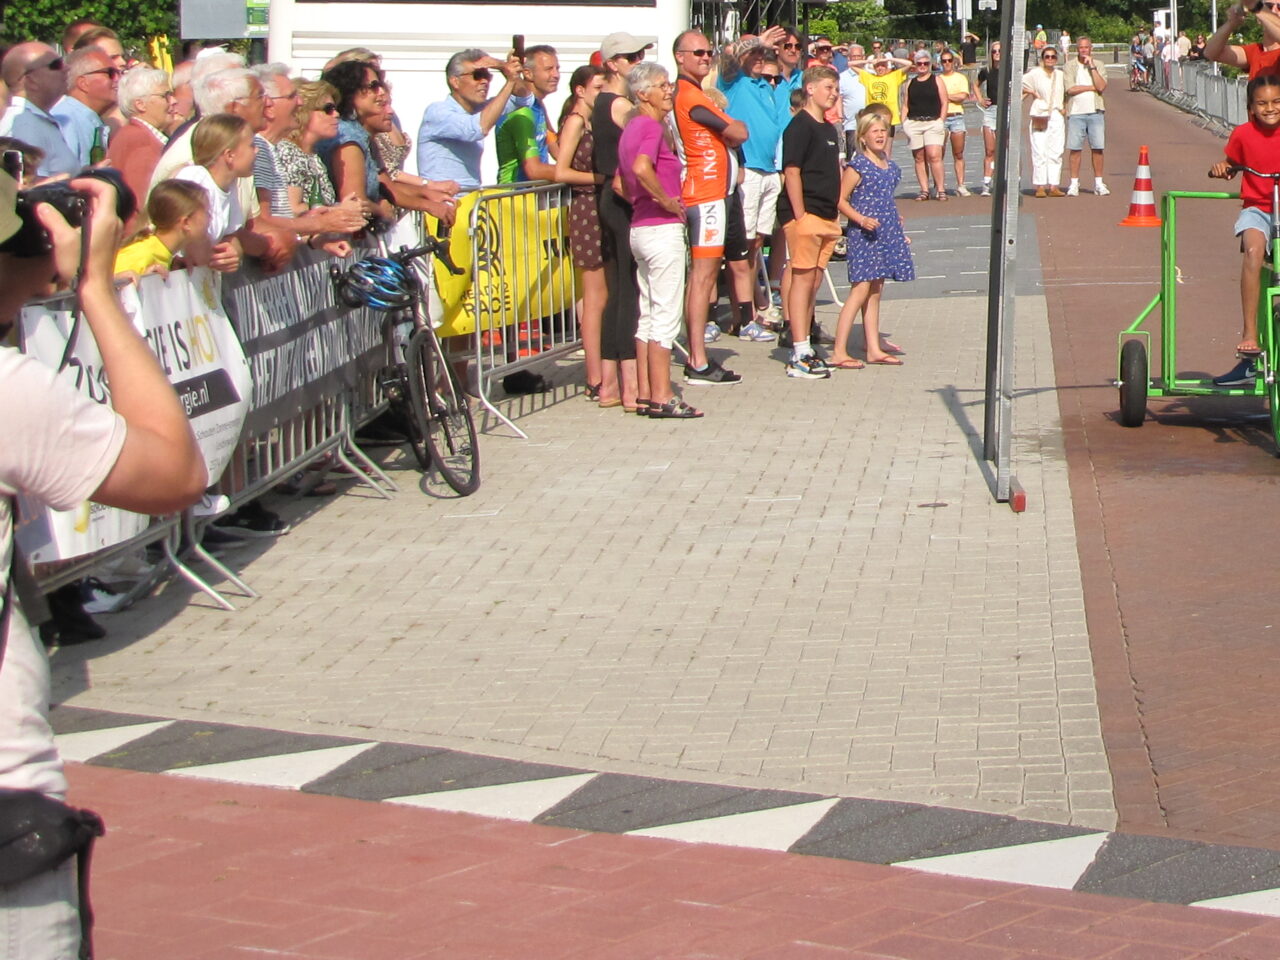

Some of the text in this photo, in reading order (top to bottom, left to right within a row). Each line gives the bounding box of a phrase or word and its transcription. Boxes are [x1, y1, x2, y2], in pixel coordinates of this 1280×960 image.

[703, 149, 718, 181] ING
[703, 204, 718, 226] NG
[462, 294, 511, 317] RACE
[167, 320, 191, 372] IS
[254, 348, 276, 409] HET
[180, 380, 210, 416] rgie.nl
